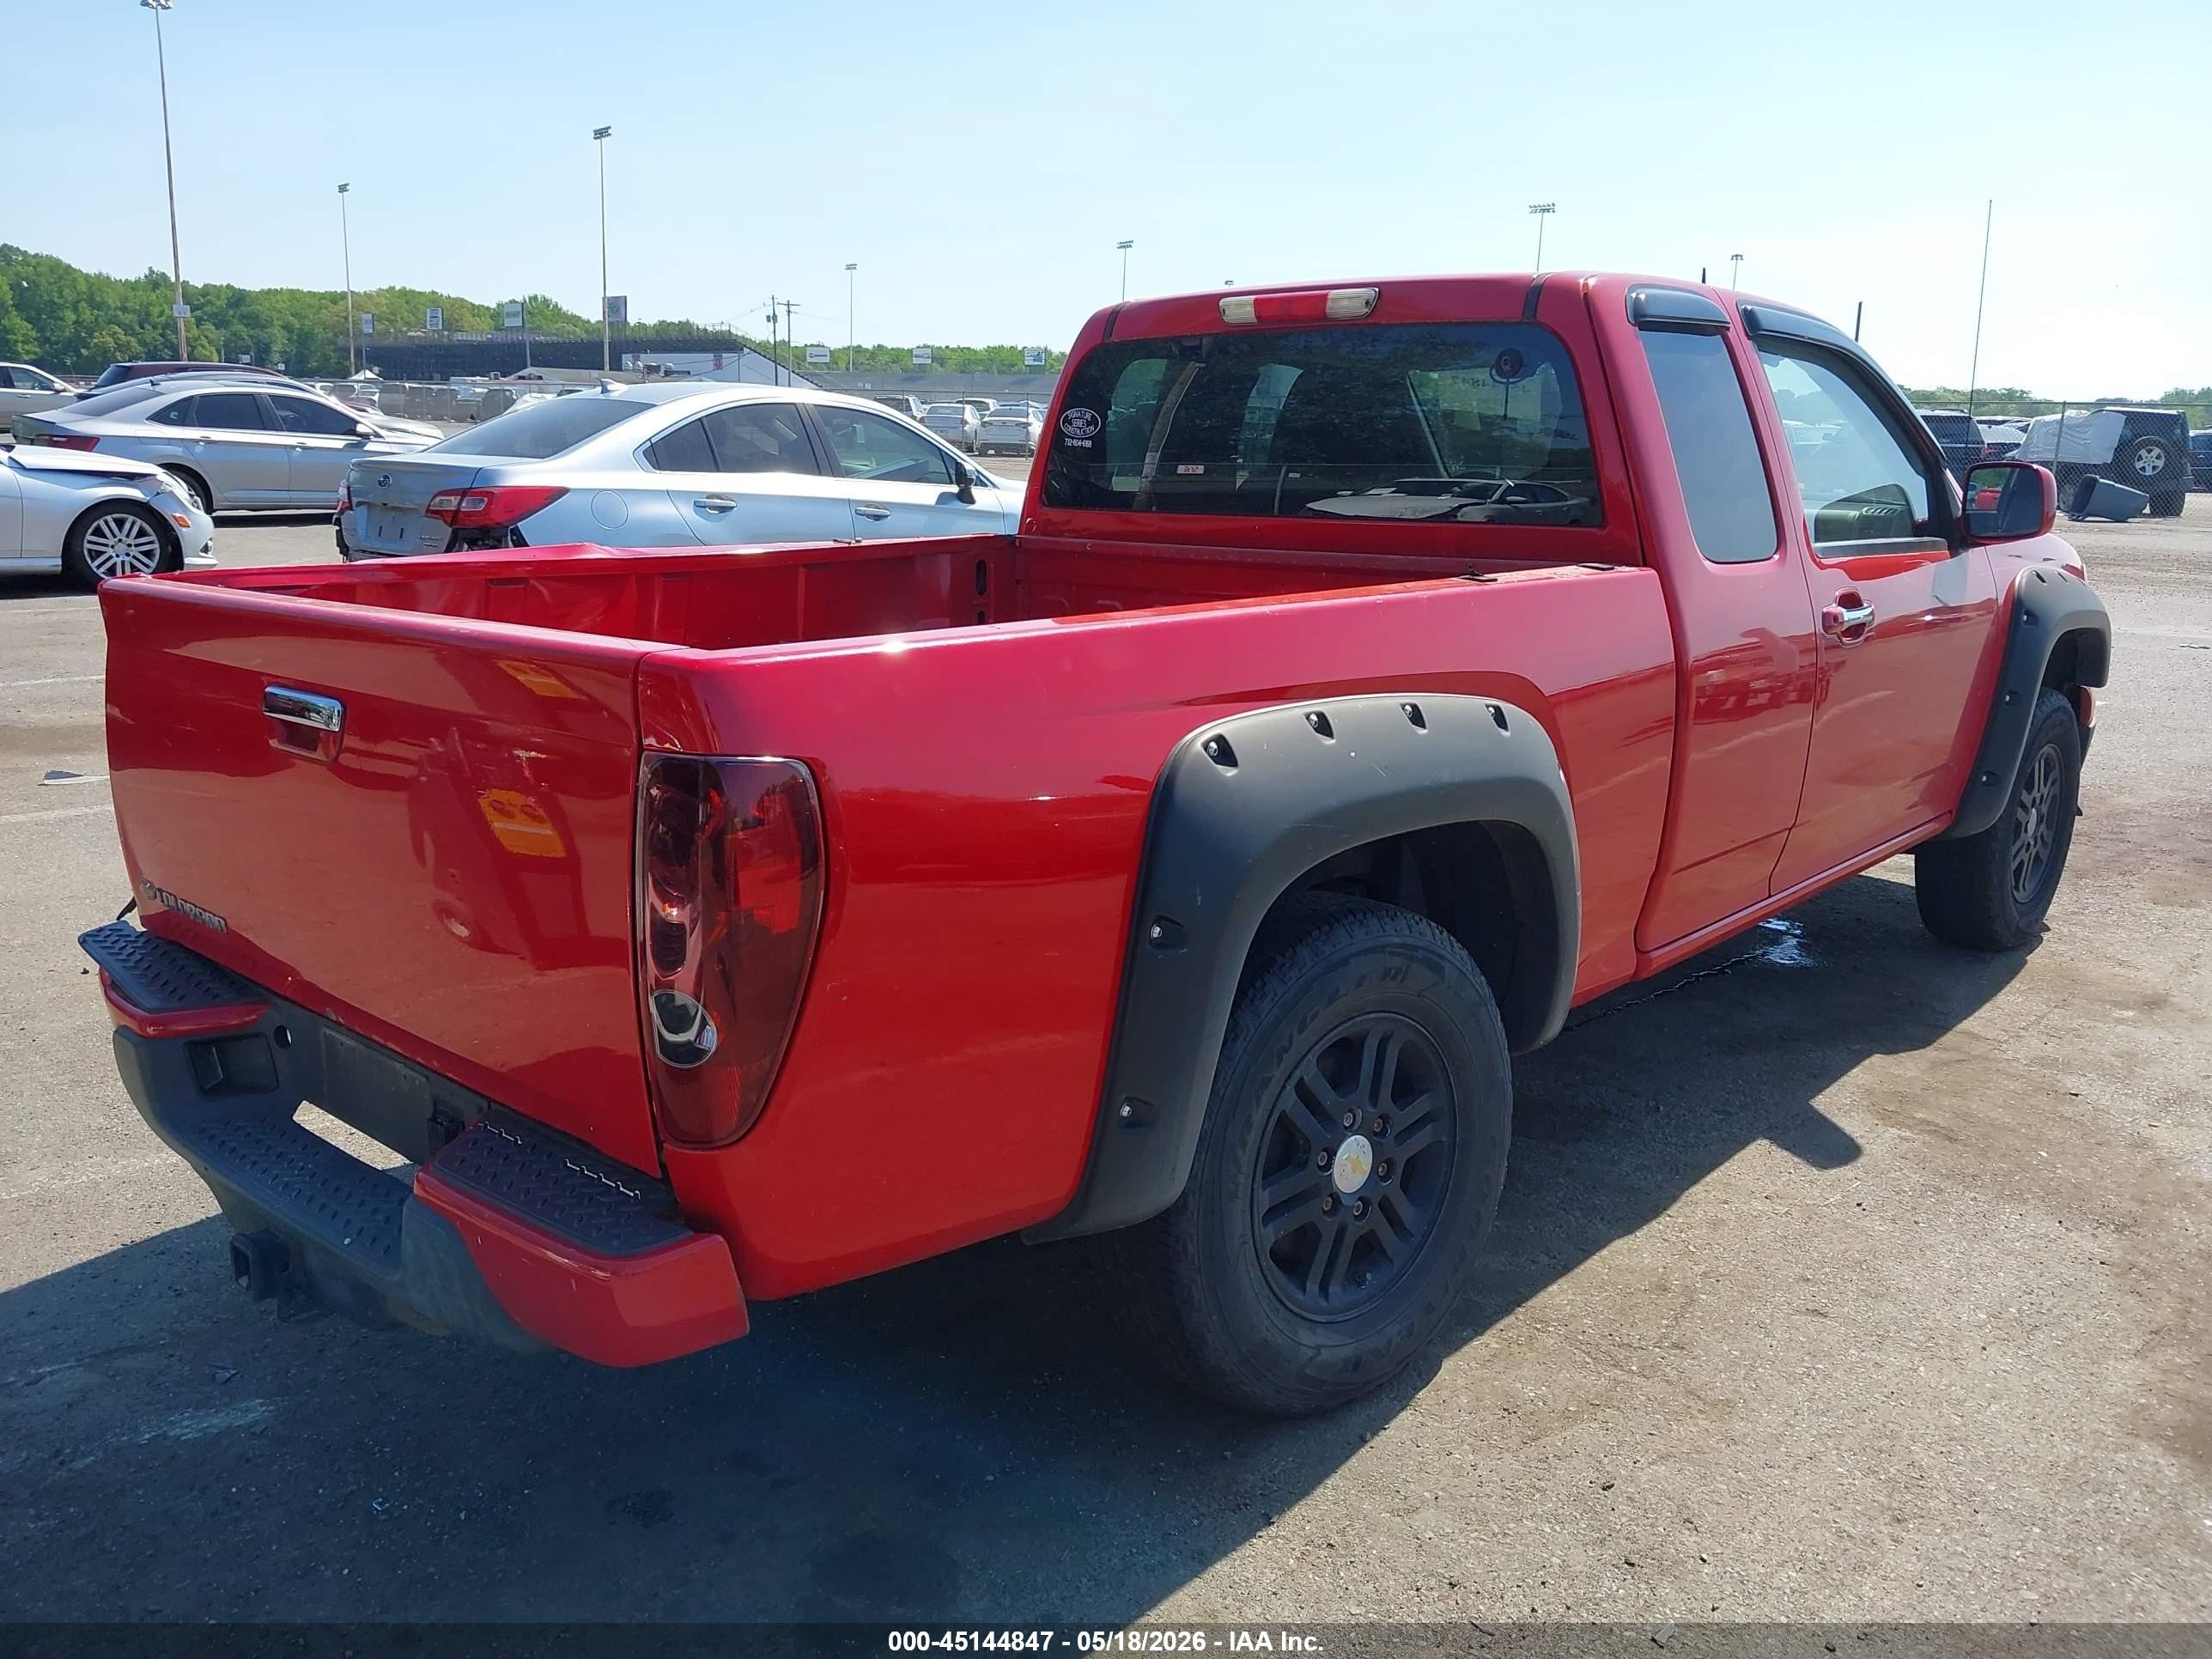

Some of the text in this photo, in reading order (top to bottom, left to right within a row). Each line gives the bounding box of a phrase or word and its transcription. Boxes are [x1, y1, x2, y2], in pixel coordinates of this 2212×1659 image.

[1068, 411, 1092, 421] SIGNATURE
[1072, 419, 1087, 428] SERIES
[1064, 423, 1095, 435] CONSTRUCTION
